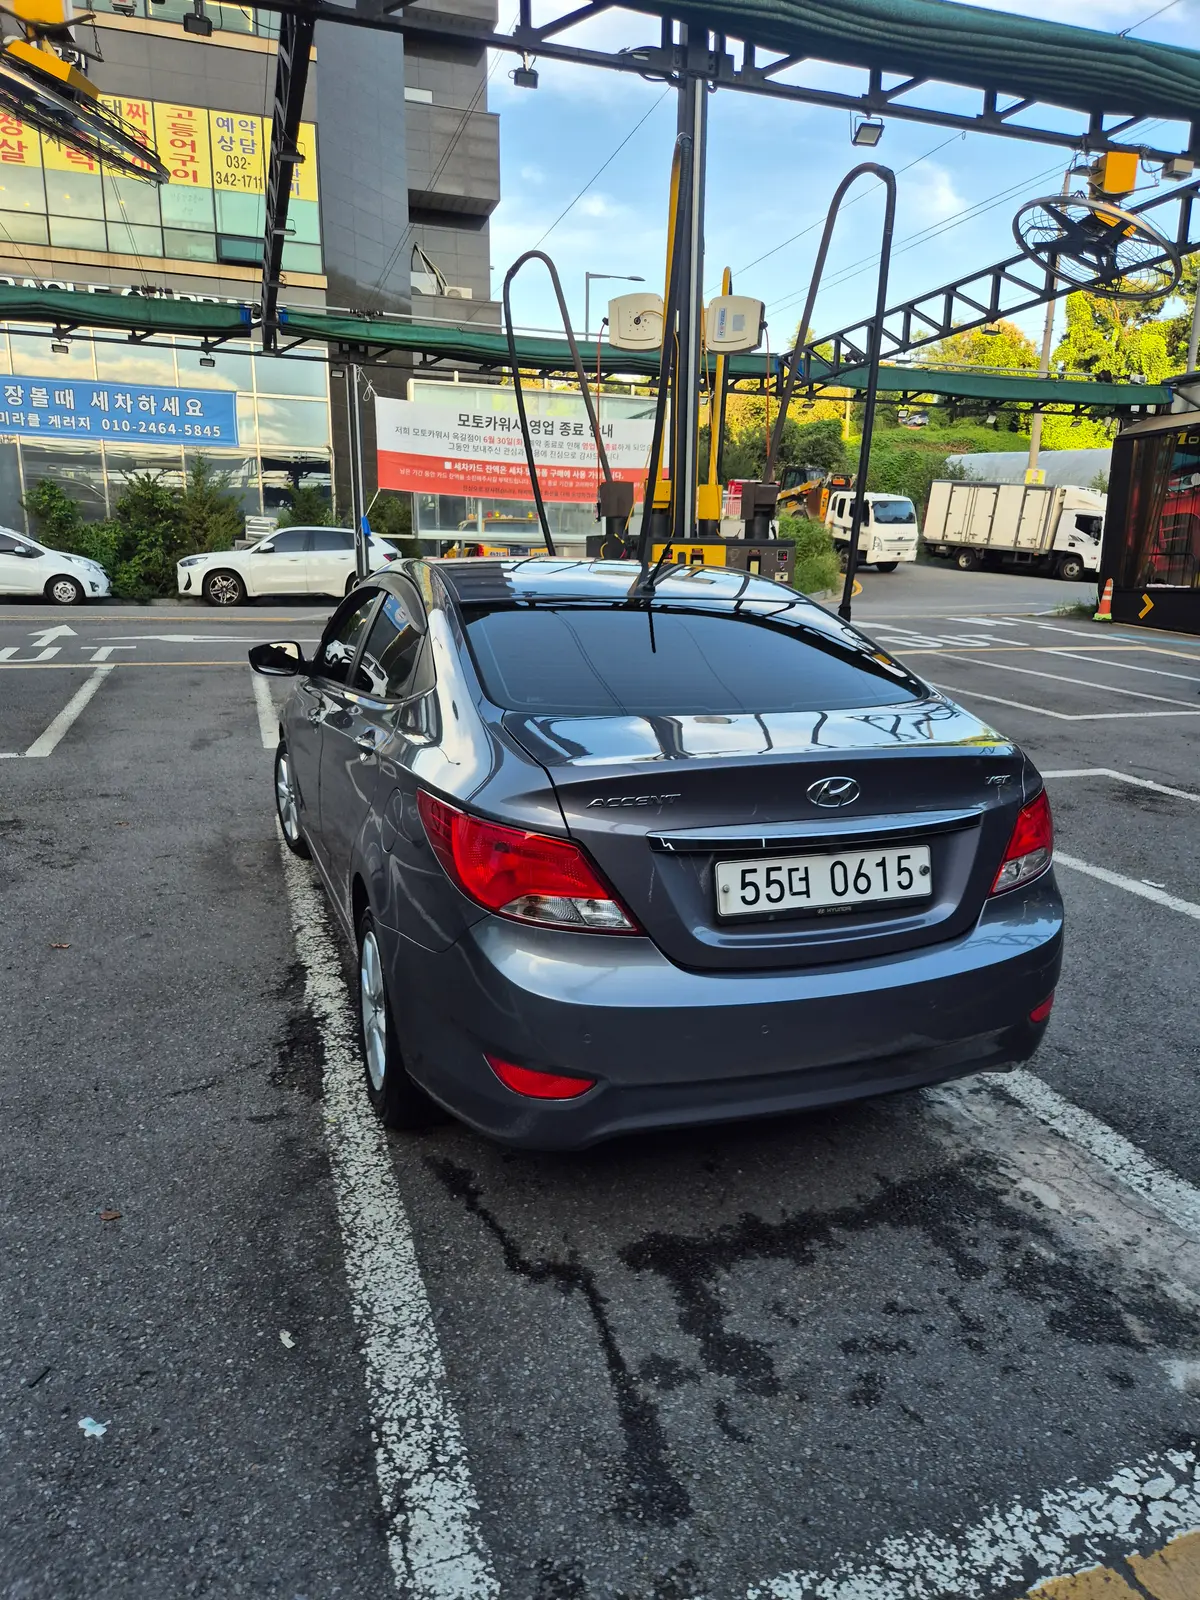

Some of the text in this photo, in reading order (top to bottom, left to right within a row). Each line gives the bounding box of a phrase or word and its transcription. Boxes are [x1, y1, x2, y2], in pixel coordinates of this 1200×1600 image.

[216, 116, 257, 136] 예약
[166, 107, 200, 183] 고등어구이
[217, 136, 258, 155] 상담
[225, 154, 252, 170] 032-
[215, 171, 264, 190] 342-1711
[4, 385, 204, 417] 장볼때 세차하세요
[0, 411, 222, 437] 미라클 게러지 010-2464-5845
[529, 420, 554, 436] 영업
[560, 421, 584, 437] 종료
[395, 426, 410, 436] 저희
[412, 428, 450, 440] 모토카워시
[452, 432, 482, 443] 옥길점이
[483, 436, 495, 445] 6월
[497, 437, 524, 446] 30일(화
[544, 440, 564, 449] 종료로
[566, 442, 580, 450] 인해
[604, 443, 631, 452] 종료하게
[448, 442, 470, 452] 그동안
[472, 444, 501, 455] 보내주신
[503, 447, 524, 457] 관심과
[533, 449, 548, 458] 용에
[550, 450, 577, 460] 진심으로
[454, 462, 483, 473] 세차카드
[485, 464, 507, 475] 잔액은
[509, 466, 524, 476] 세차
[550, 469, 571, 479] 구매에
[572, 470, 587, 480] 사용
[0, 646, 137, 662] UT
[585, 793, 682, 809] ACCENT
[740, 854, 914, 906] 55더 0615
